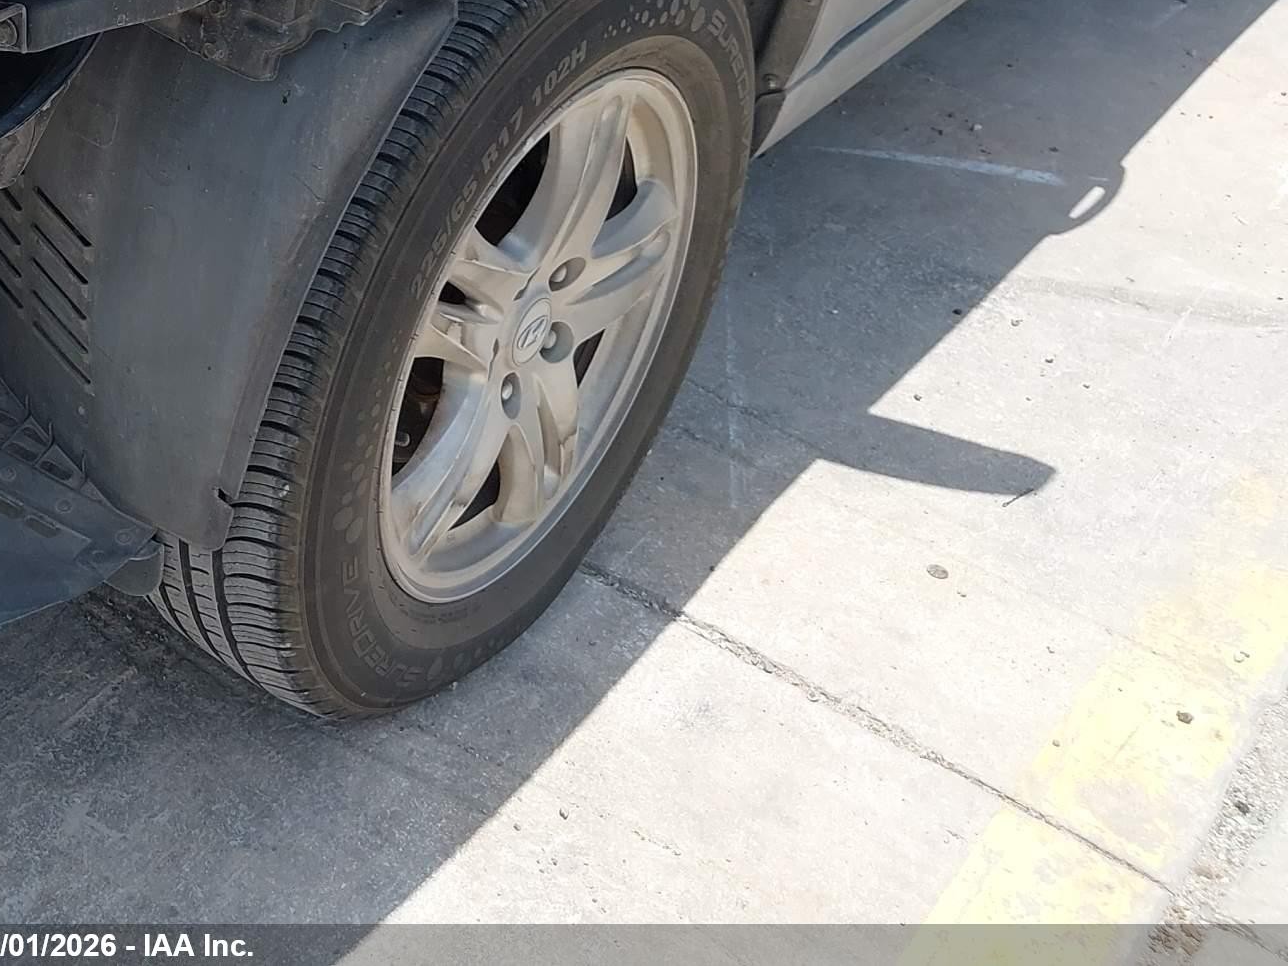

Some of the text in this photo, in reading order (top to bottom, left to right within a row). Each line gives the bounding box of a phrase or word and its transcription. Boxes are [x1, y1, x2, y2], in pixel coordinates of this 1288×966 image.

[409, 39, 588, 300] 225/65 R17 102H
[342, 555, 425, 687] SUREDRIVE
